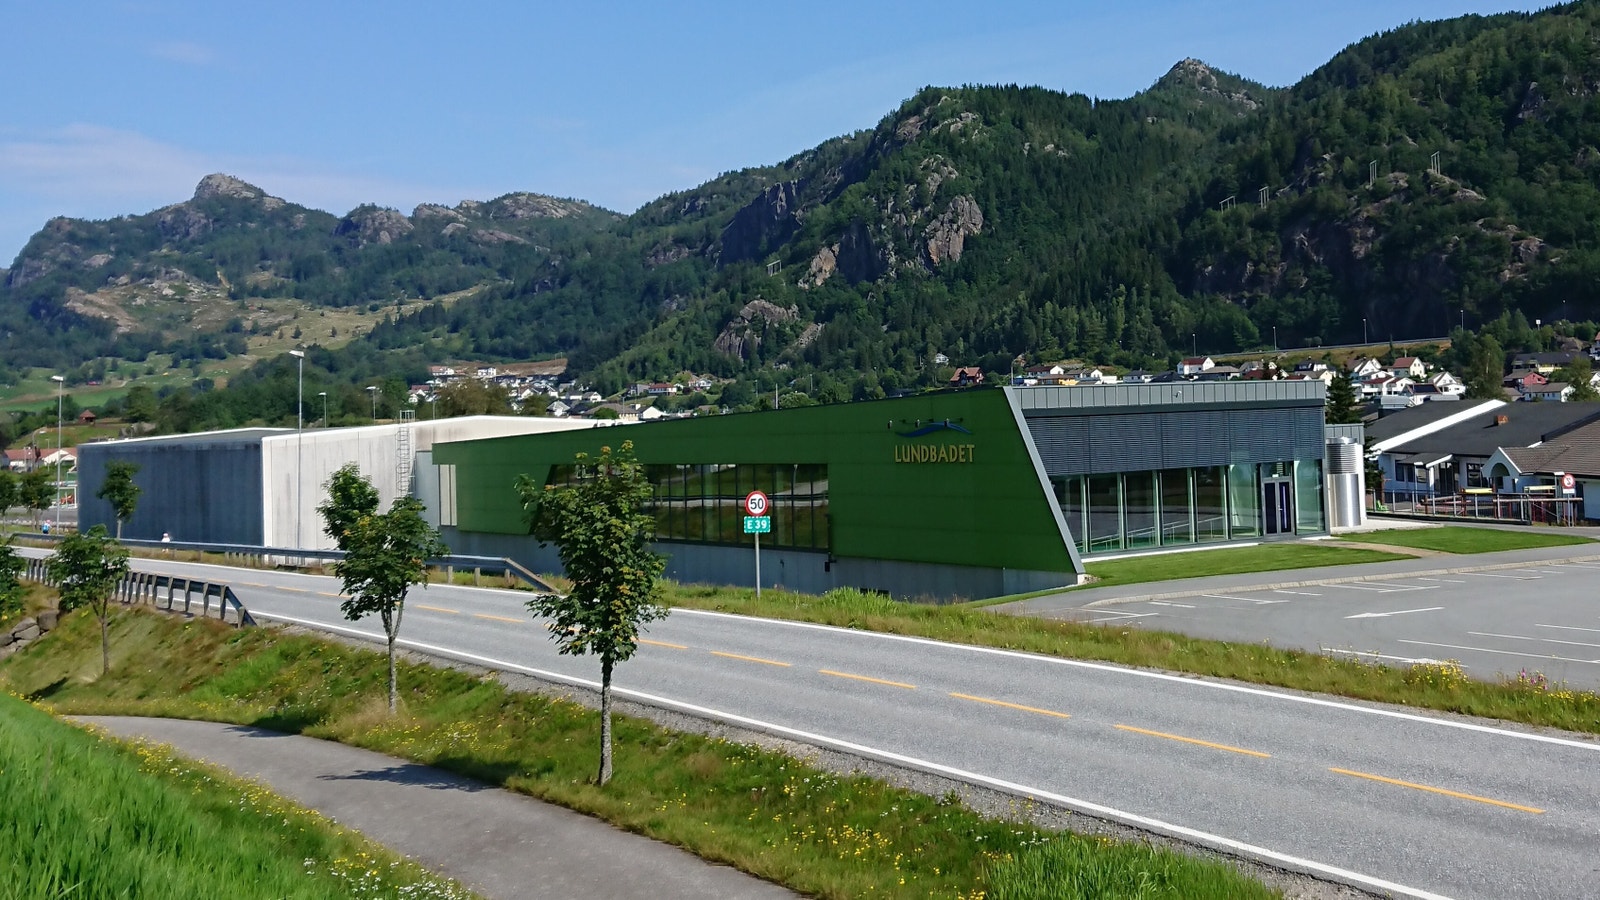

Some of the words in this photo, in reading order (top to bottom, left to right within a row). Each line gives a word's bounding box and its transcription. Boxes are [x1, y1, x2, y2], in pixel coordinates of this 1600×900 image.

[895, 443, 975, 463] LUNDBADET
[750, 498, 764, 510] 50
[747, 520, 753, 529] E
[755, 520, 767, 529] 39
